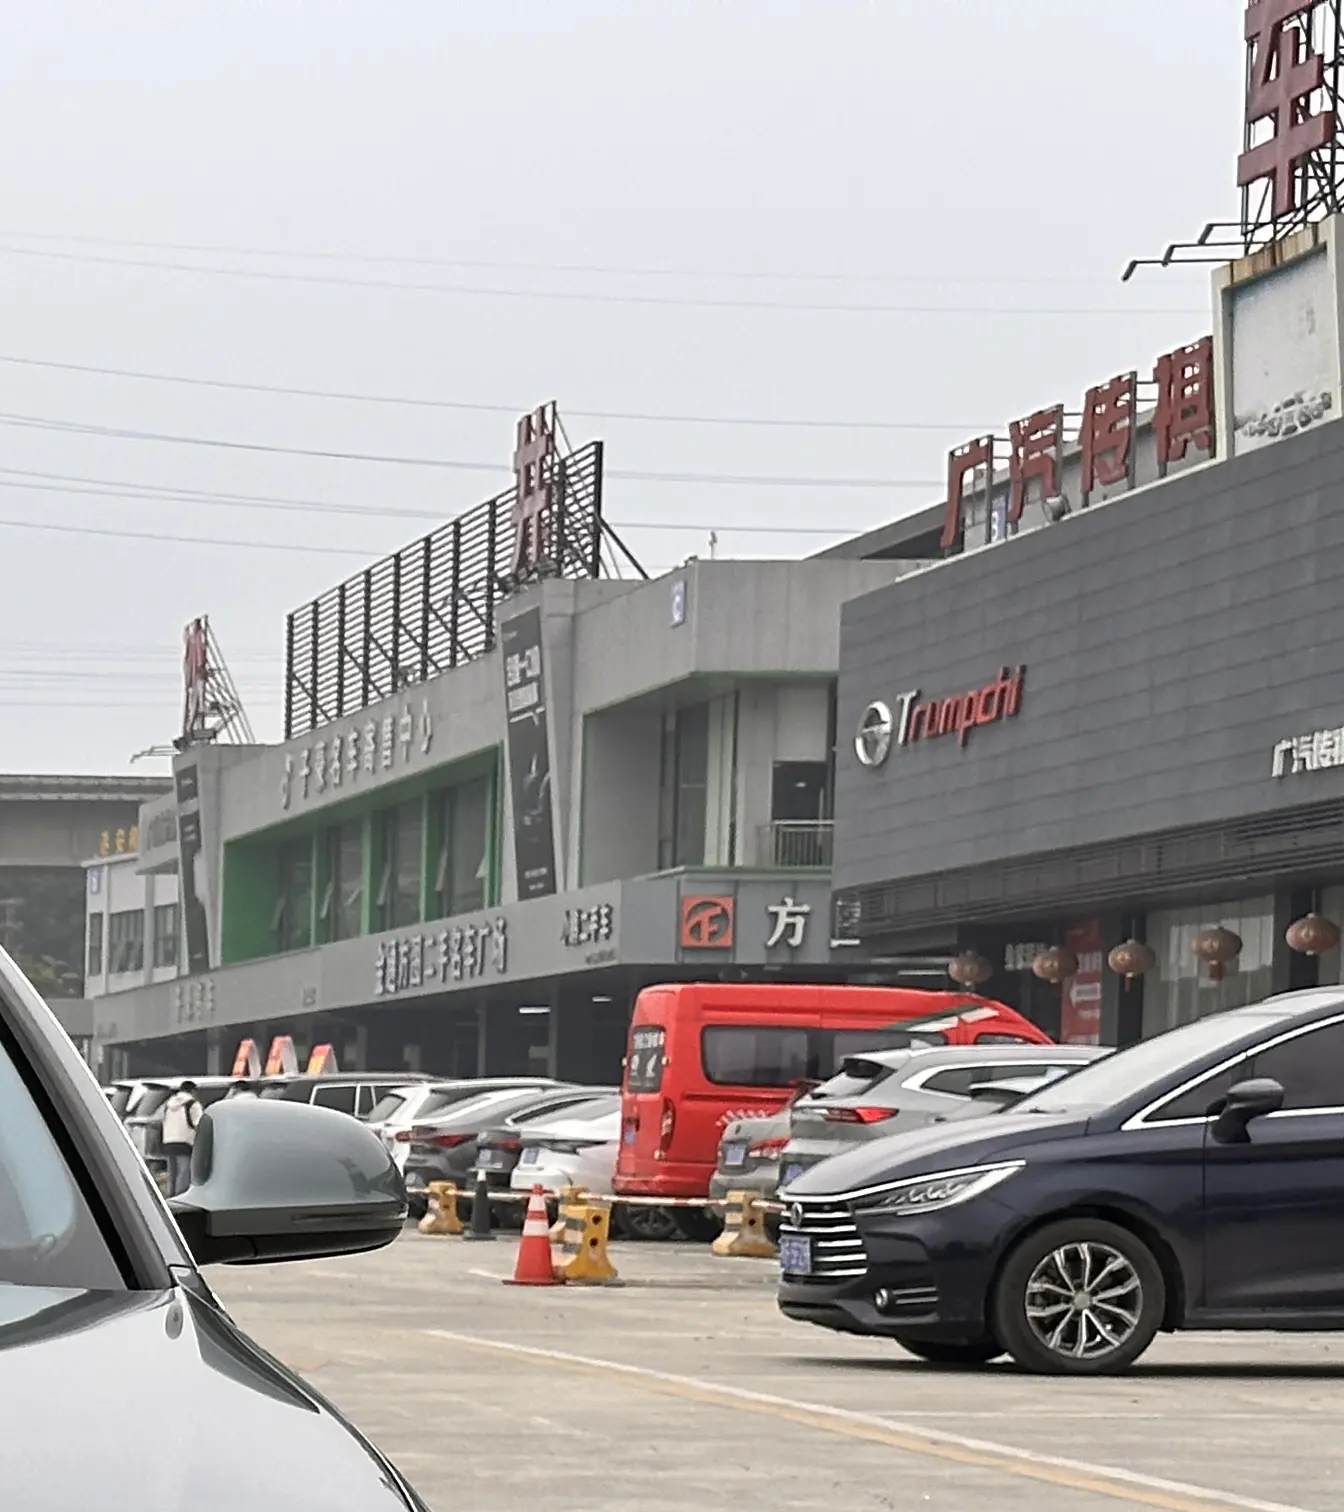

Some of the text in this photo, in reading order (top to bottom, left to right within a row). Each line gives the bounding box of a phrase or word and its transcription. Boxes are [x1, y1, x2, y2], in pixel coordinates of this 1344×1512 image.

[940, 335, 1213, 549] 广汽传祺
[896, 664, 1026, 746] Trumpchi
